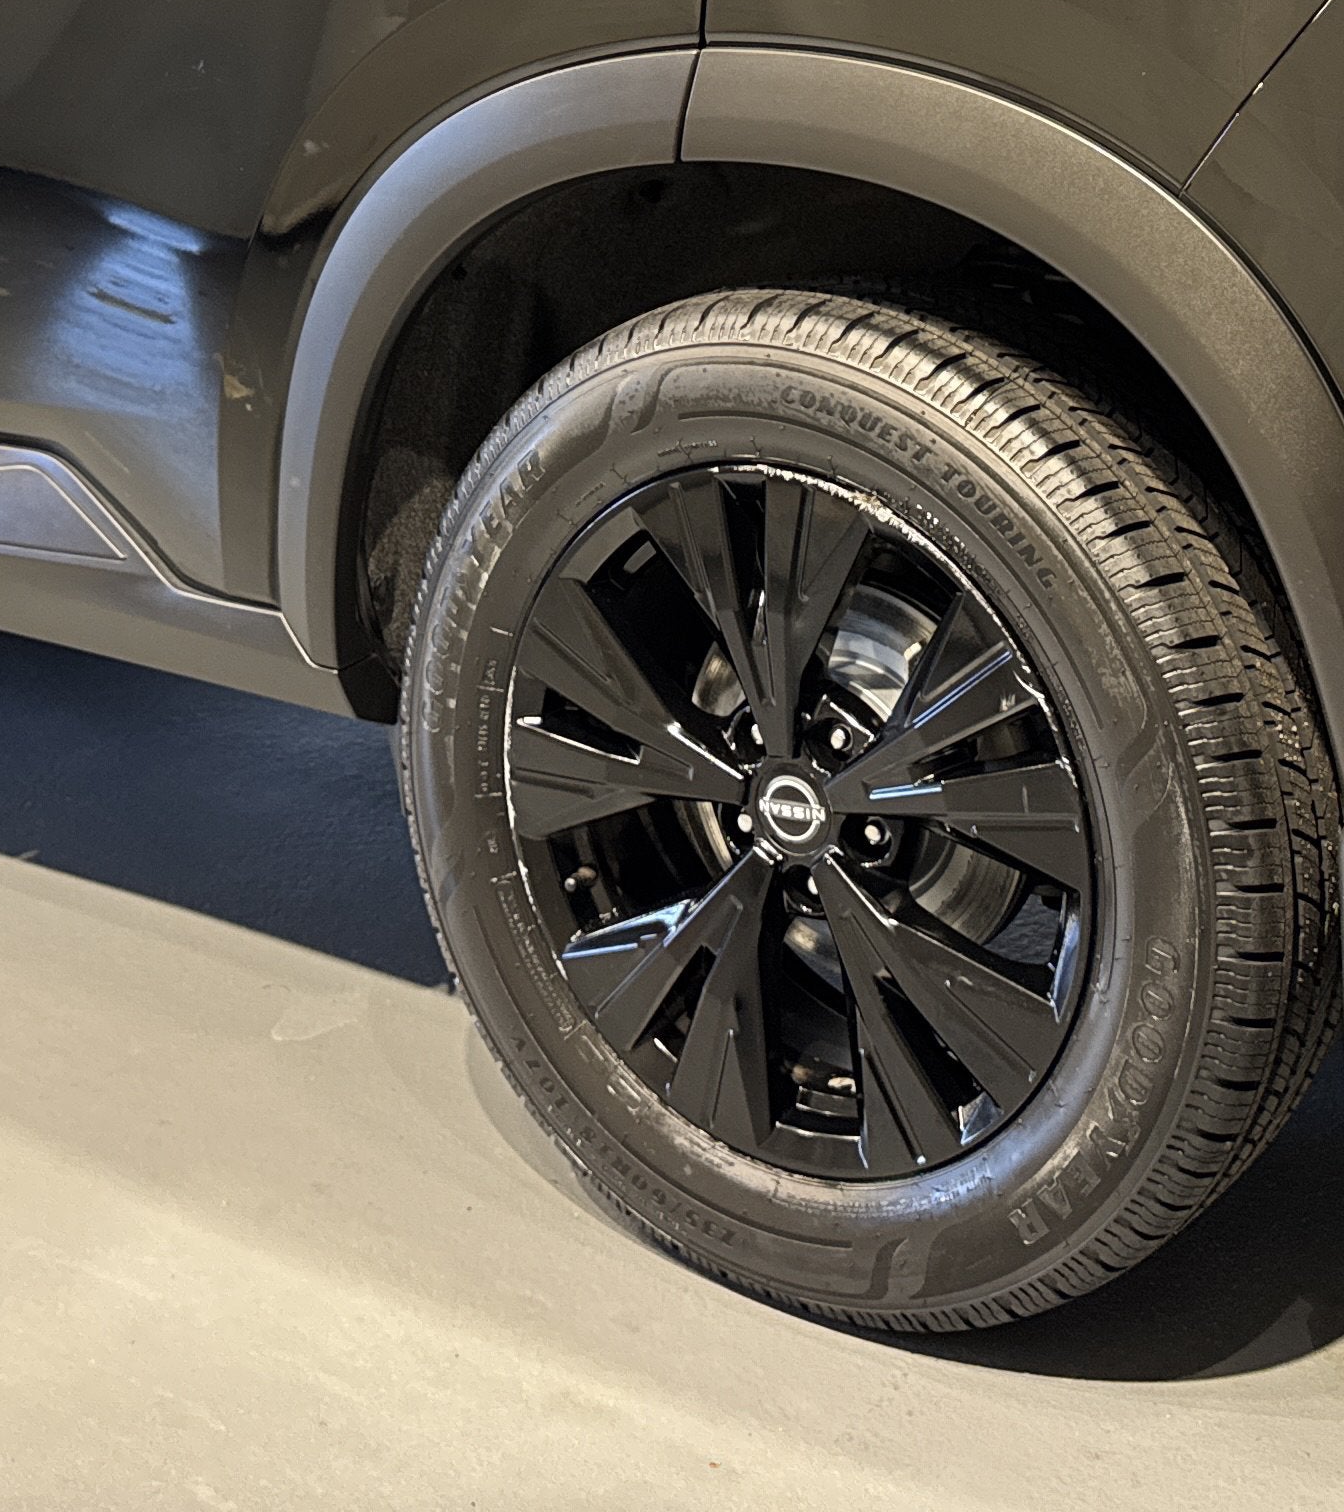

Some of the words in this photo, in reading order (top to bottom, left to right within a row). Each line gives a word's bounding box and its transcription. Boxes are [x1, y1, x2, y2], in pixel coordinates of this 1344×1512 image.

[779, 385, 937, 464] CONQUEST
[942, 462, 1058, 590] TOURING
[759, 797, 826, 822] NISSAN
[1007, 937, 1180, 1246] GOODYEAR
